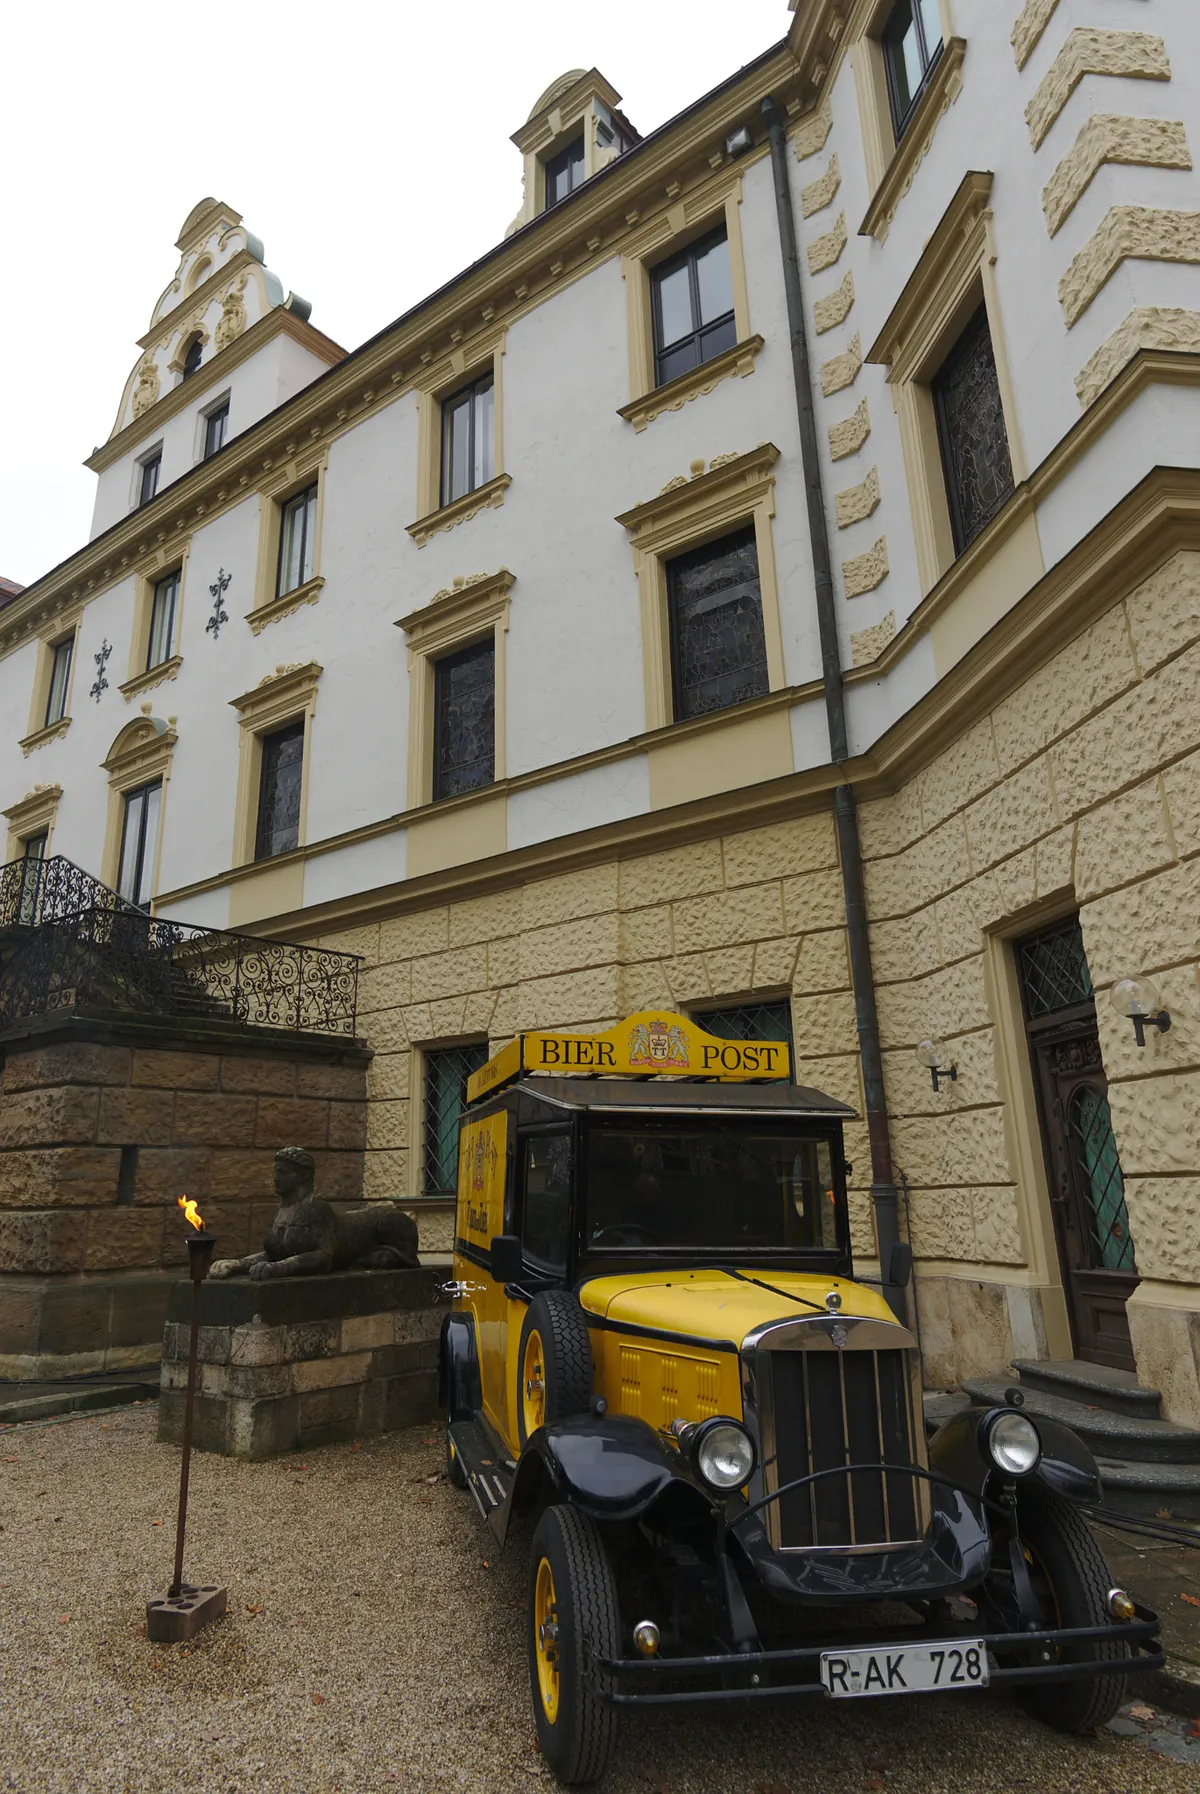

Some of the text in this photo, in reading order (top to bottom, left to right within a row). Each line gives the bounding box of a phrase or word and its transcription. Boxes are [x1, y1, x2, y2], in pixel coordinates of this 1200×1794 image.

[539, 1039, 617, 1066] BIER
[700, 1045, 779, 1071] POST
[651, 1047, 667, 1056] TT
[827, 1647, 982, 1693] R-AK 728
